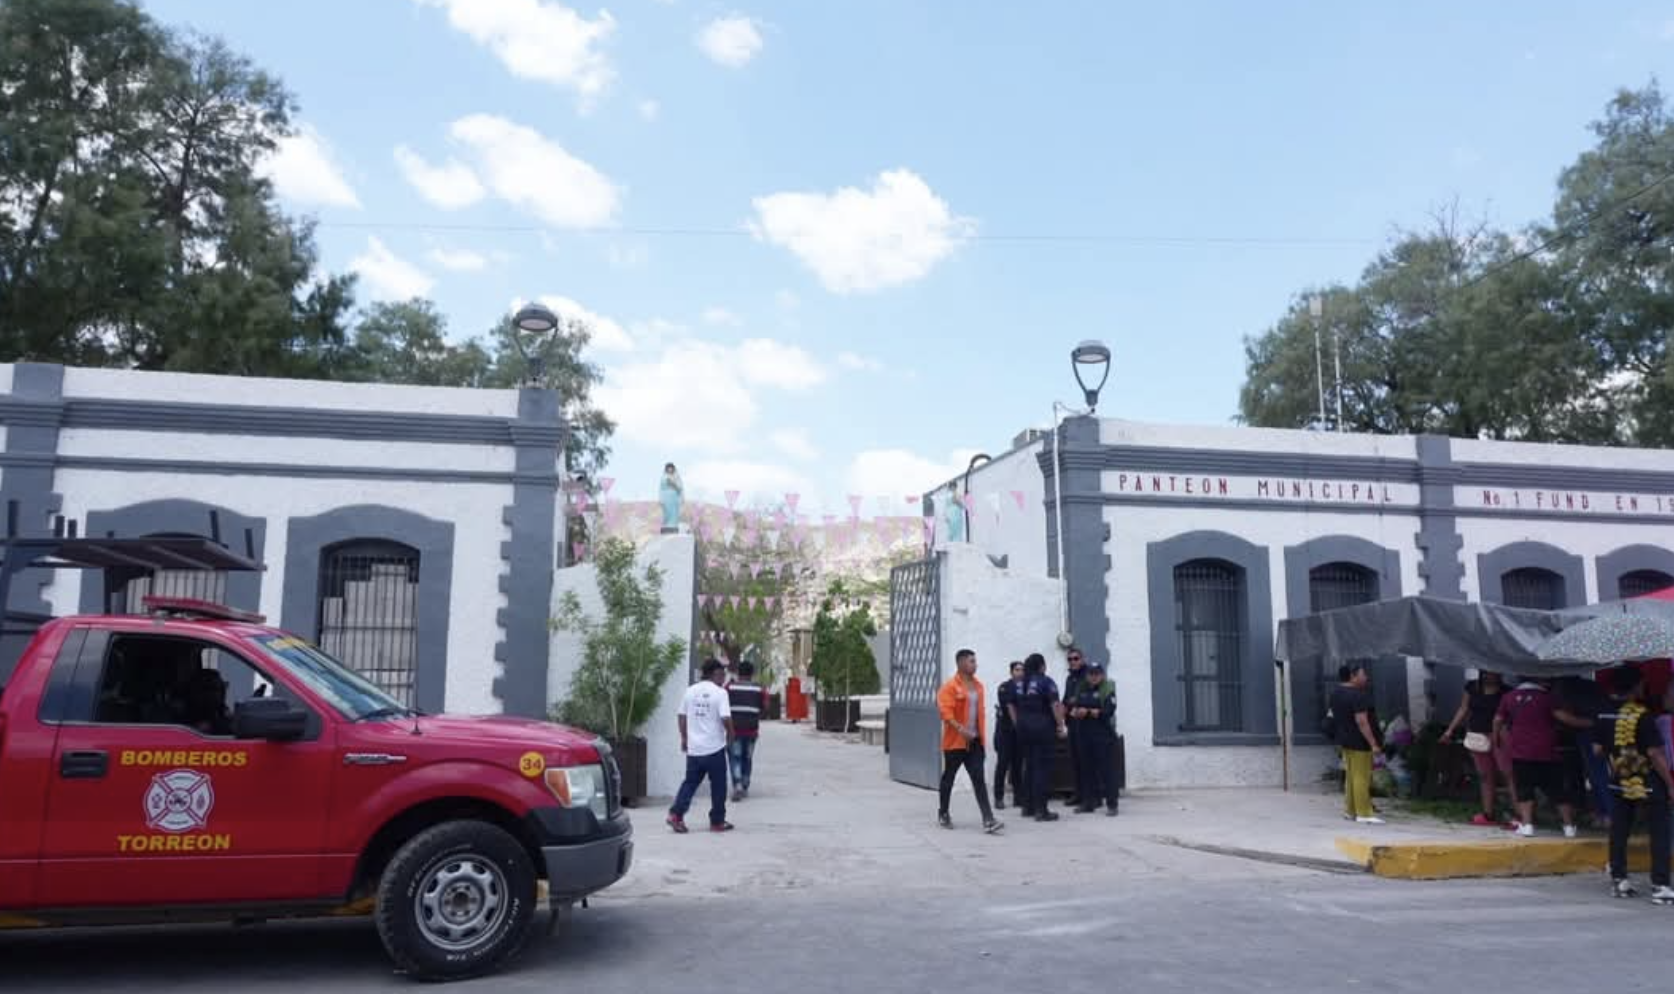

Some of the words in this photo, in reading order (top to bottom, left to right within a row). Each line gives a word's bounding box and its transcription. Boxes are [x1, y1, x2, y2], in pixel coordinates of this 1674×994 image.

[1118, 474, 1228, 495] PANTEON
[1257, 479, 1392, 502] MUNICIPAL
[1513, 490, 1520, 505] 1
[1615, 494, 1638, 511] EN
[121, 750, 248, 767] BOMBEROS
[522, 757, 541, 771] 34
[117, 834, 231, 852] TORREON
